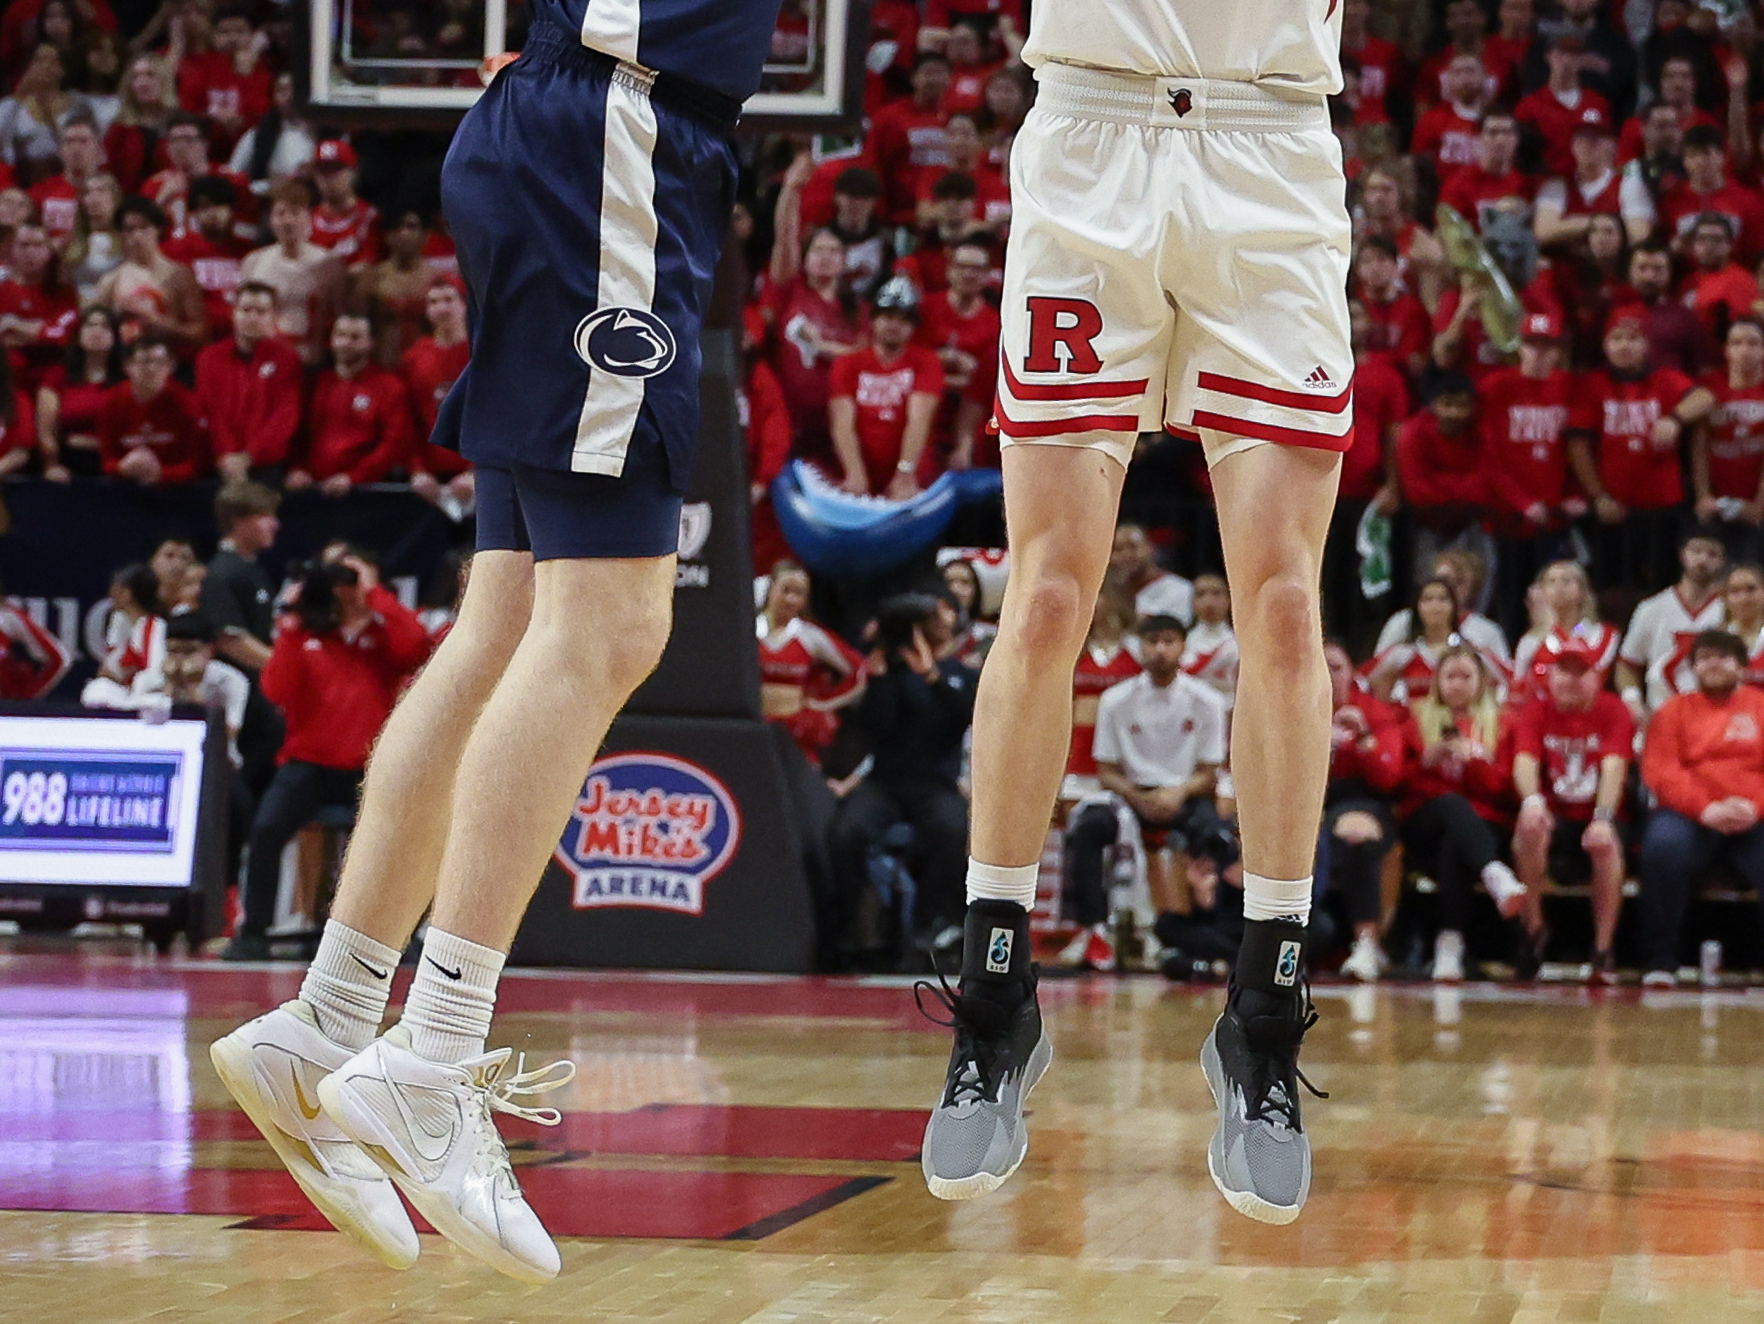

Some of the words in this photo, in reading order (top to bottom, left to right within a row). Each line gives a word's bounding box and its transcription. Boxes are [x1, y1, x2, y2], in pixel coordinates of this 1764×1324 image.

[1023, 295, 1105, 375] R
[2, 770, 68, 827] 988
[579, 782, 709, 832] Jersey
[584, 876, 691, 903] ARENA
